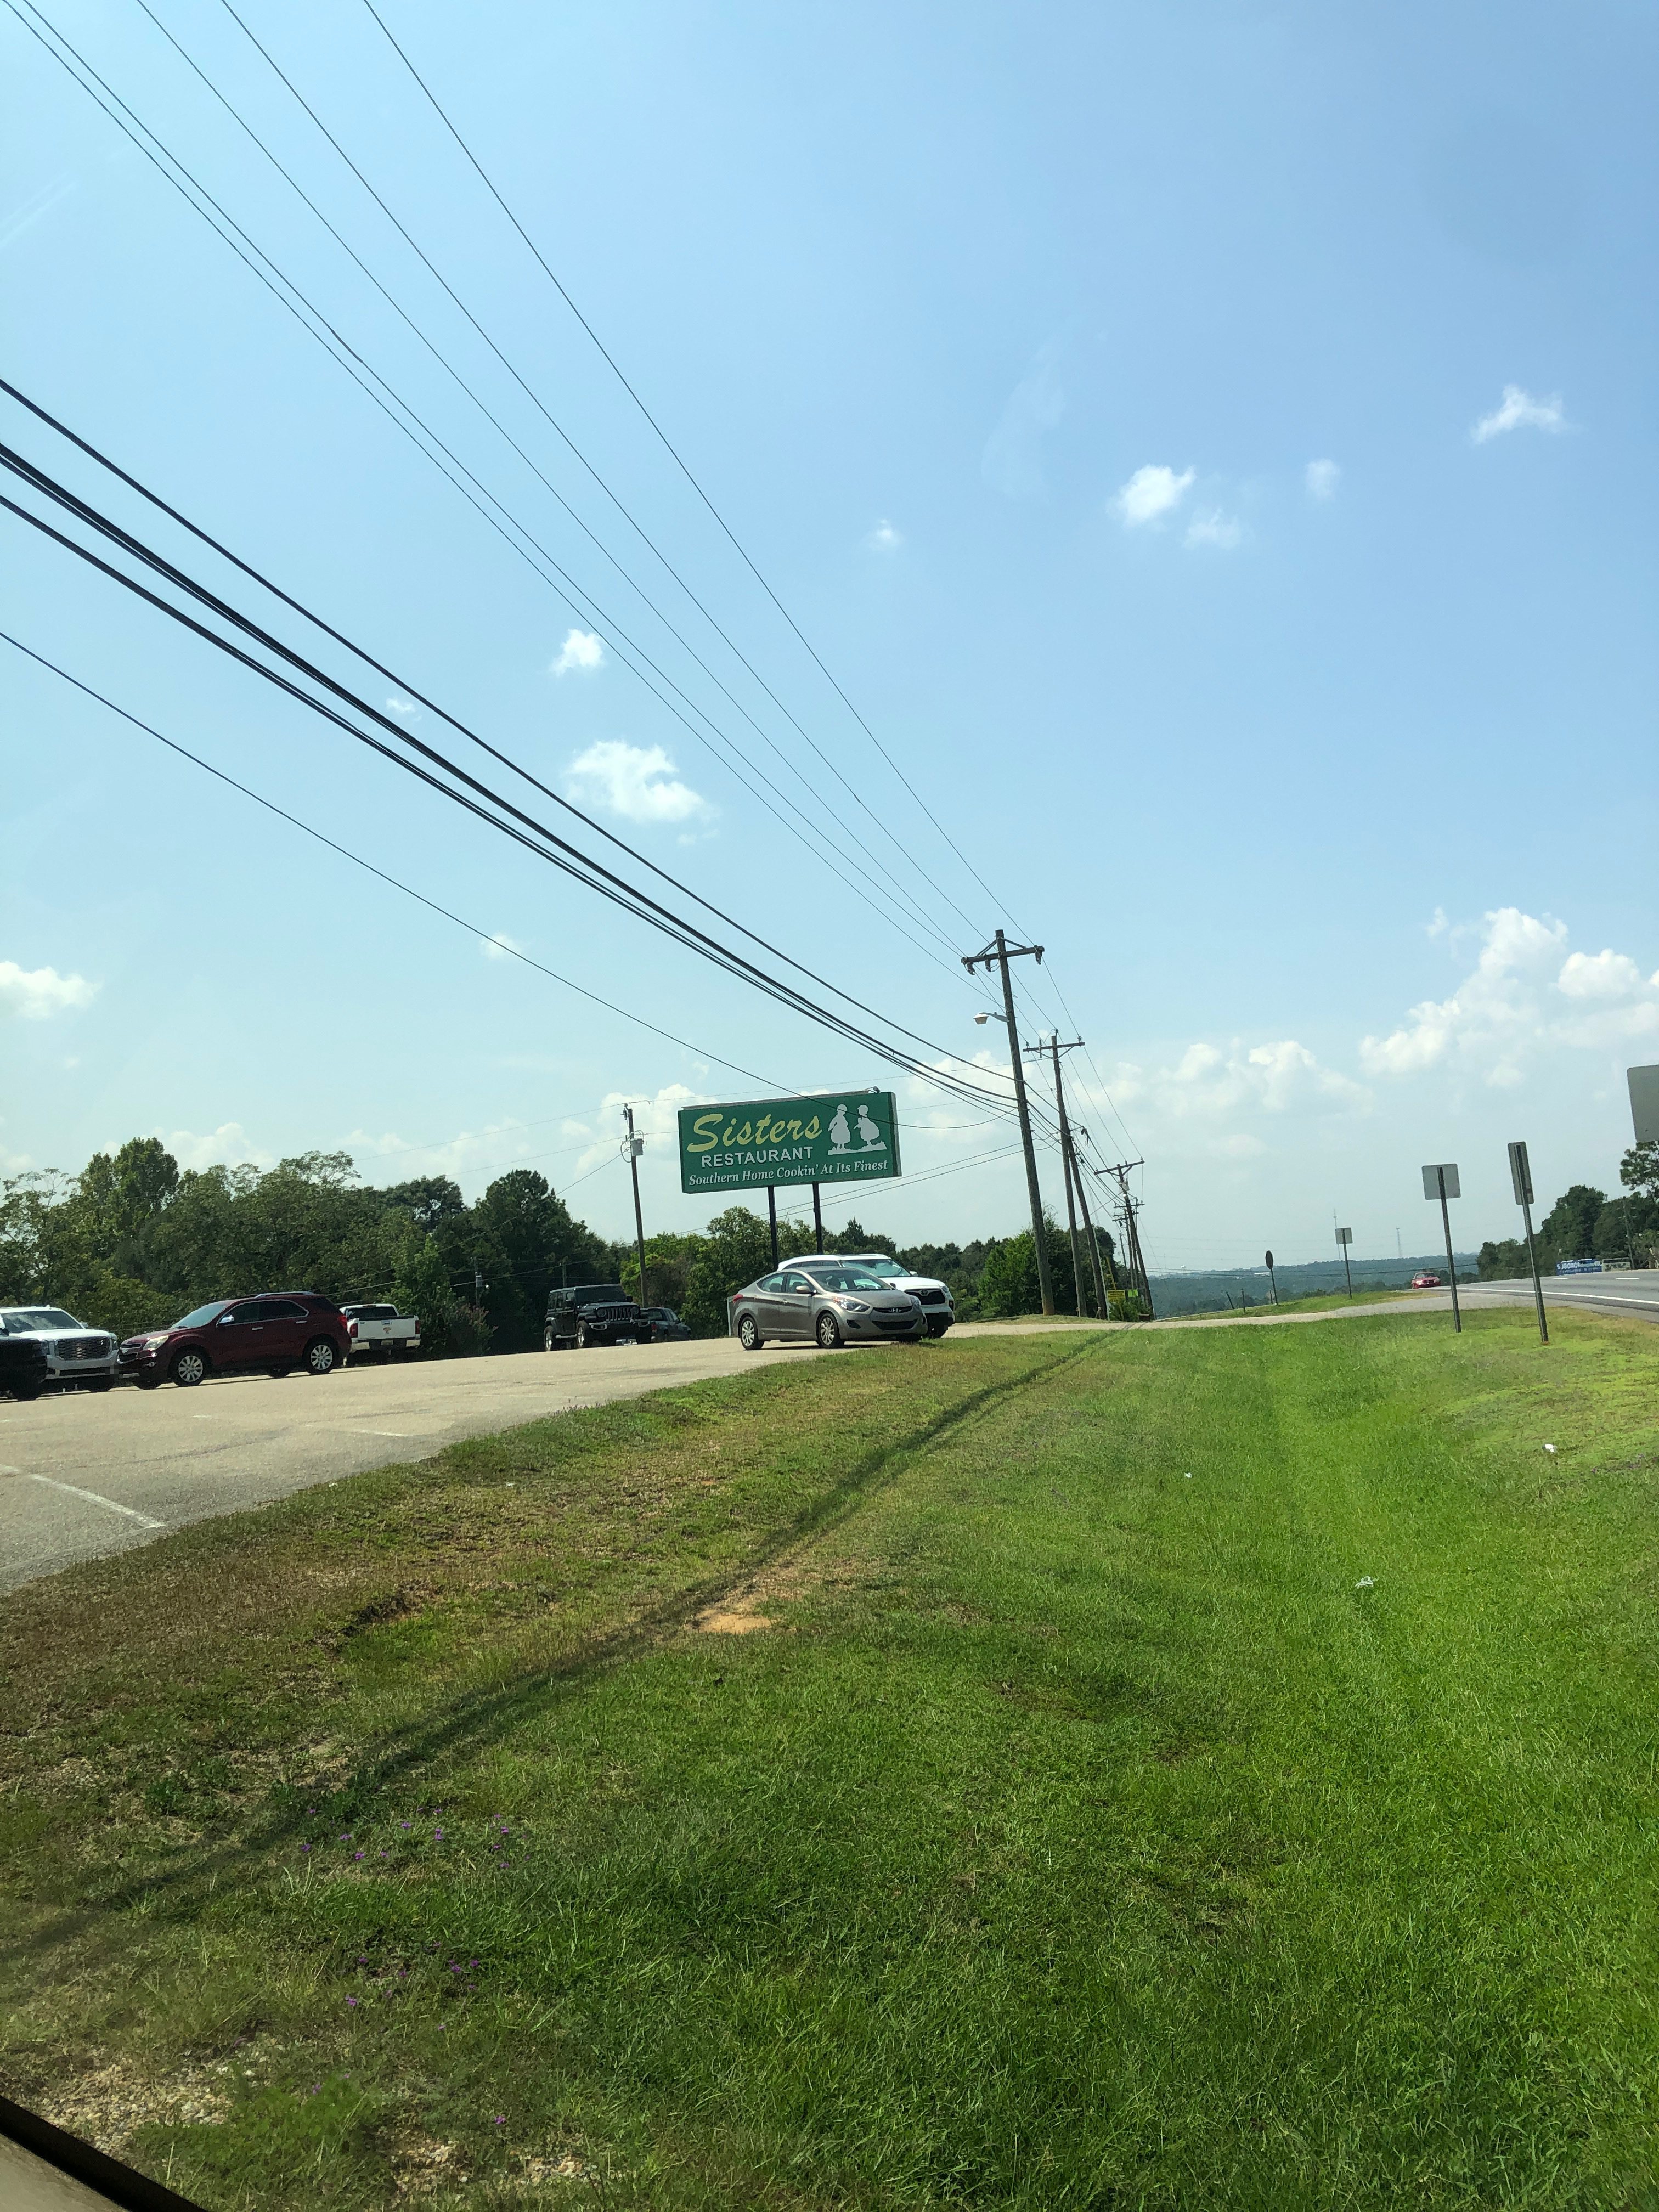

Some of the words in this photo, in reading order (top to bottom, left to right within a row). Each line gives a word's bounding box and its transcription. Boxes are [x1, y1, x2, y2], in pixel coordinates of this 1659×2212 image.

[687, 1113, 823, 1153] Sisters
[701, 1146, 814, 1168] RESTAURANT
[689, 1172, 740, 1186] Southern
[742, 1170, 774, 1181] Home
[776, 1164, 819, 1178] Cookin'
[820, 1164, 834, 1175] At
[836, 1162, 851, 1173] Its
[853, 1160, 888, 1172] Finest
